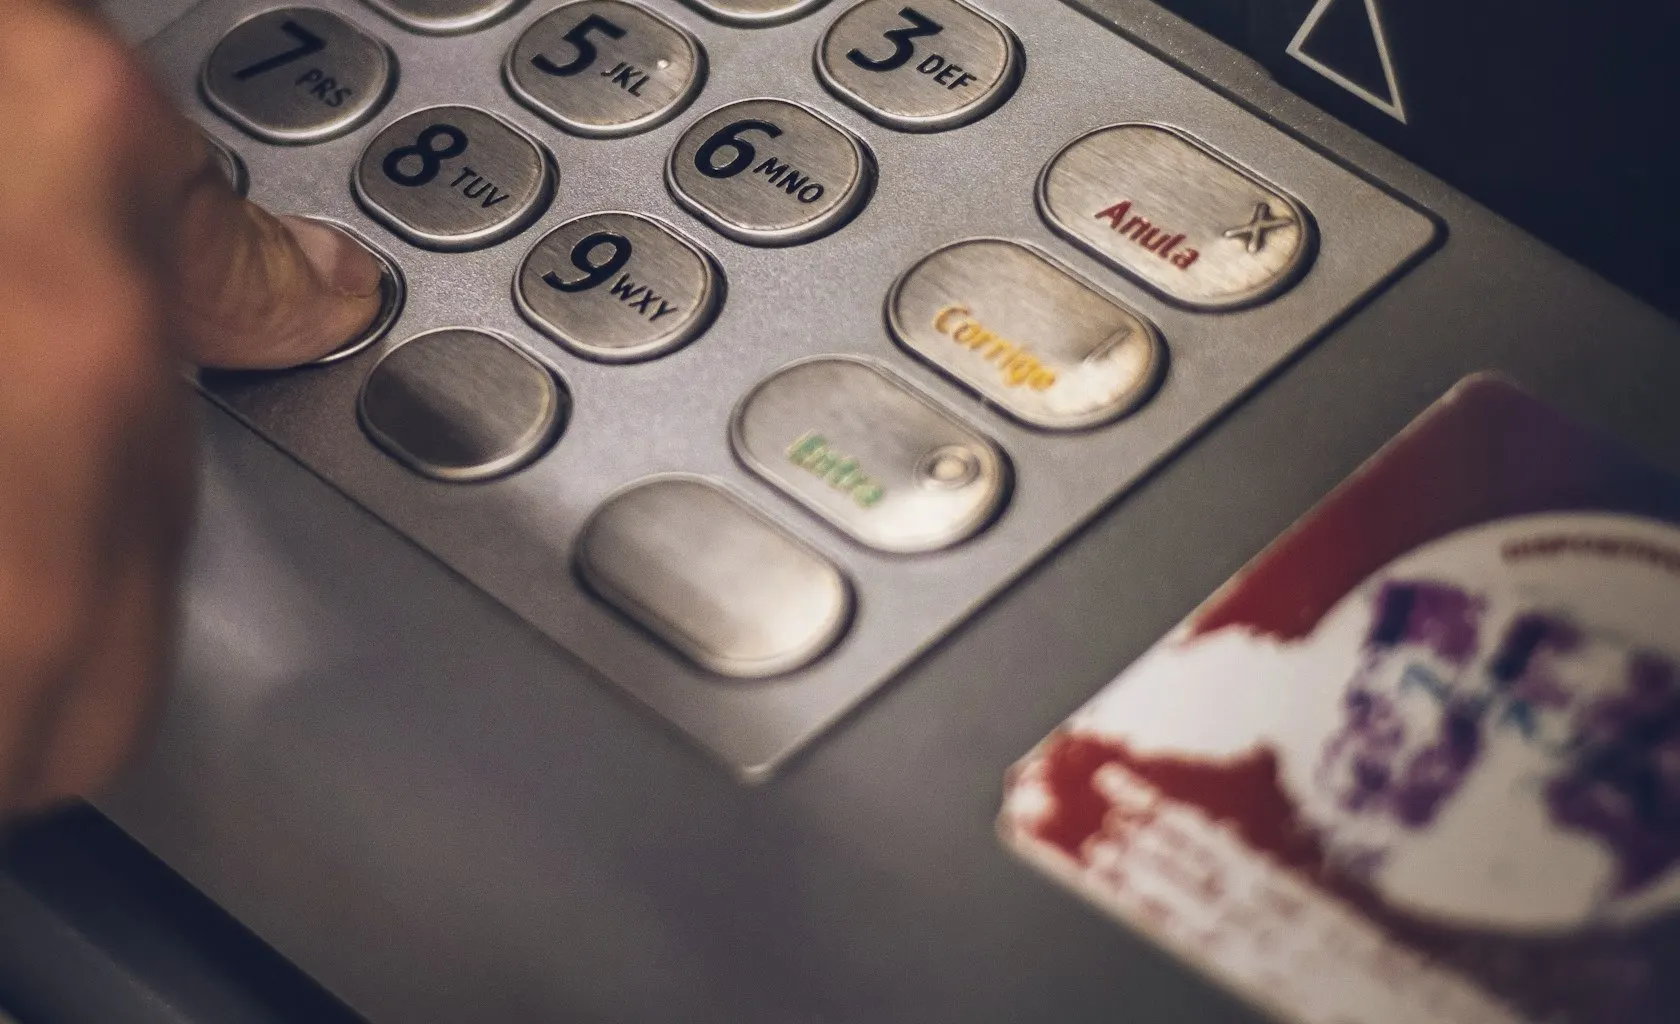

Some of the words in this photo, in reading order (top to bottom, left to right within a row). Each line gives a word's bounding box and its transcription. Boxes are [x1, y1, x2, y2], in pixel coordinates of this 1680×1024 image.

[232, 20, 327, 80] 7
[295, 68, 352, 107] PRS
[530, 13, 627, 77] 5
[600, 60, 653, 98] JKL
[845, 6, 943, 72] 3
[915, 52, 978, 91] DEF
[382, 123, 468, 187] 8
[450, 166, 509, 209] TUV
[694, 119, 783, 179] 6
[754, 156, 825, 204] MNO
[541, 231, 633, 293] 9
[609, 272, 677, 322] WXY
[1094, 200, 1199, 270] Anula
[932, 305, 1057, 392] Corrige
